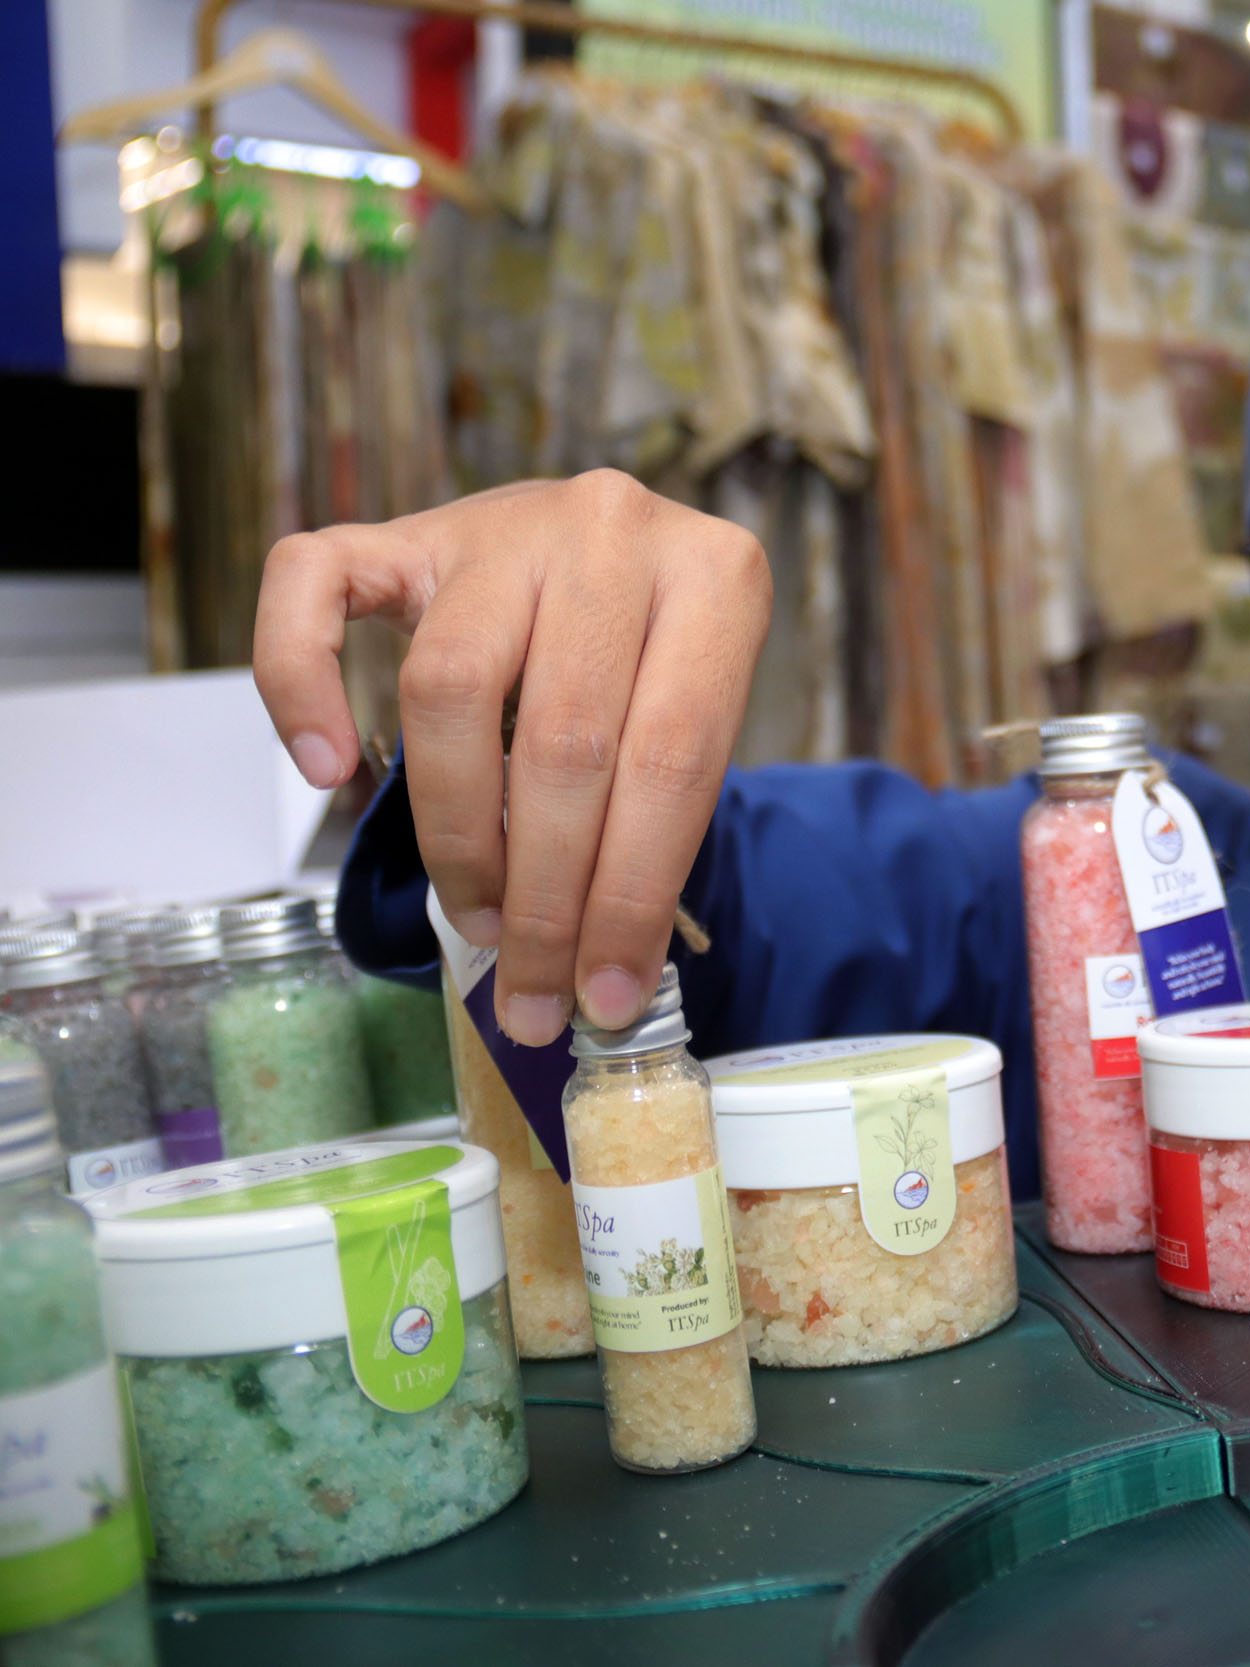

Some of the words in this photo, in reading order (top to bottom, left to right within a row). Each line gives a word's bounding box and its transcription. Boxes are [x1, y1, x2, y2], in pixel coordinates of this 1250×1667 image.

[893, 1216, 938, 1238] ITSpa
[661, 1299, 698, 1314] Produced
[698, 1296, 710, 1307] by:
[668, 1313, 710, 1333] ITSpa
[393, 1361, 447, 1393] ITSpa
